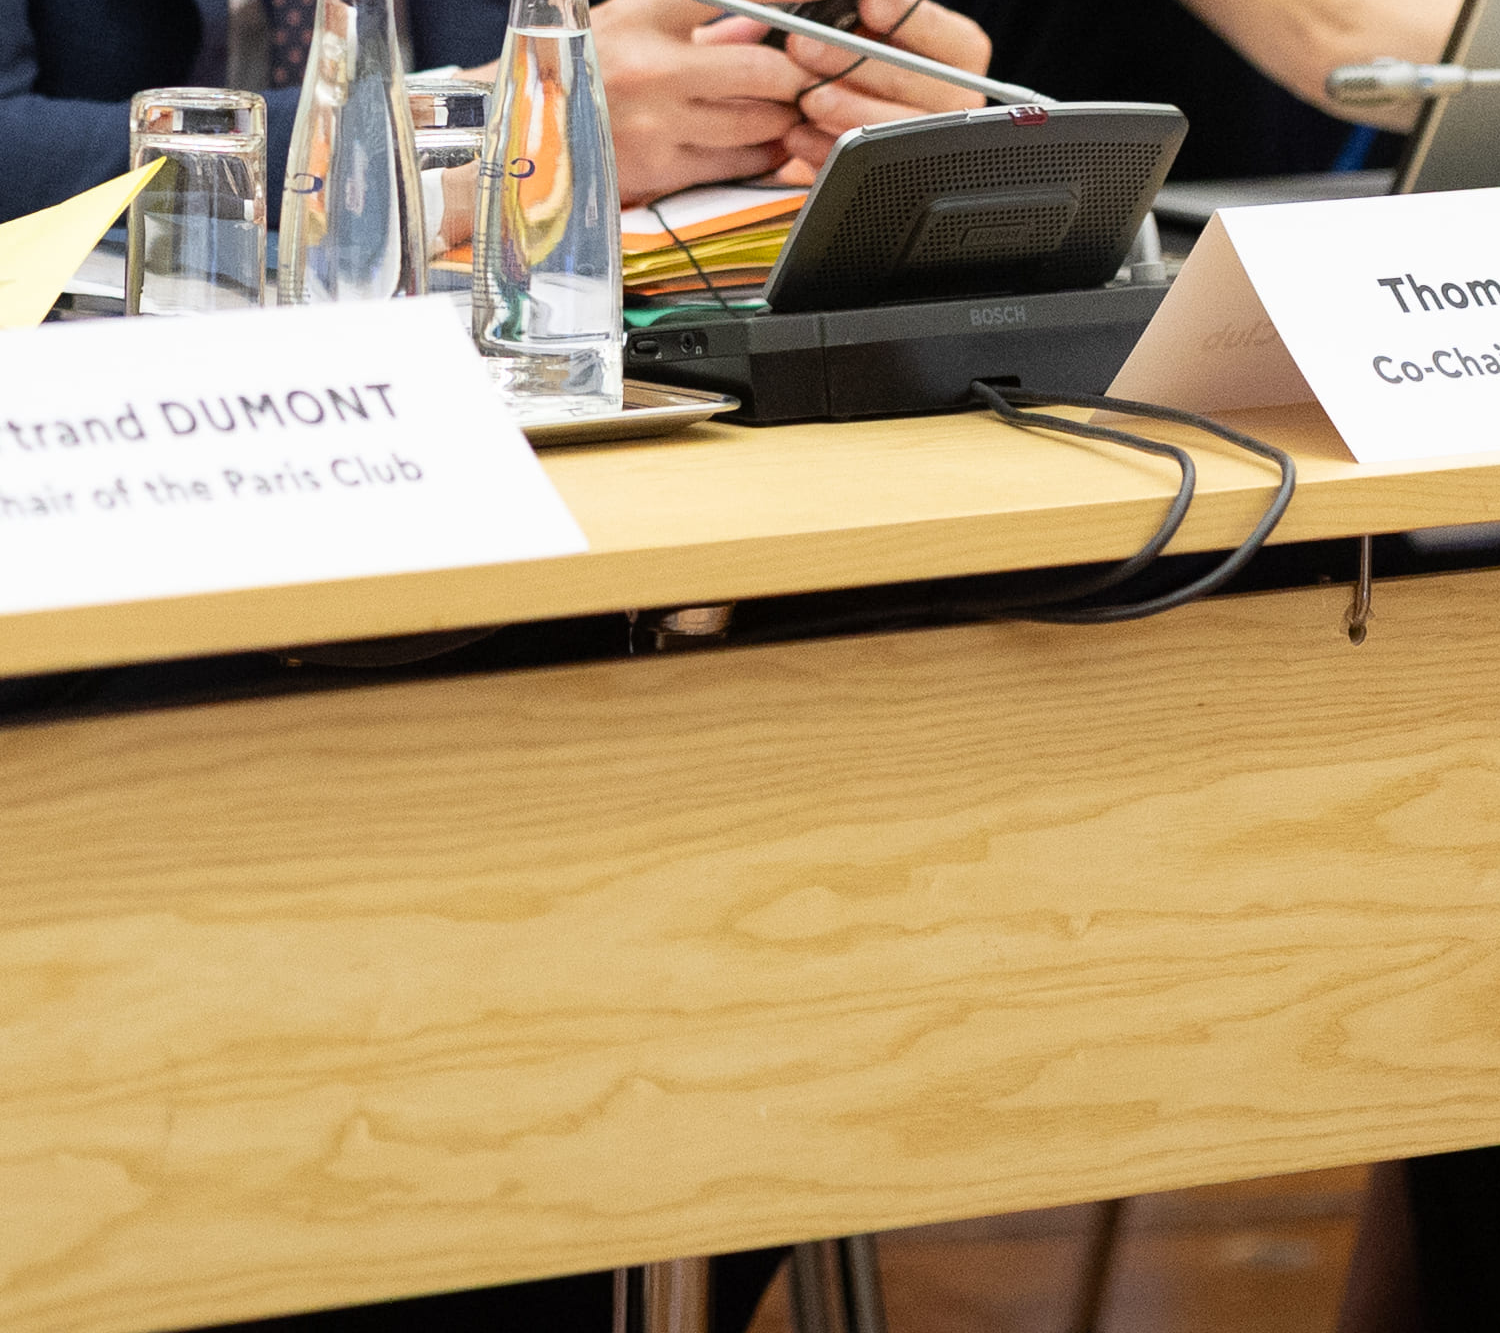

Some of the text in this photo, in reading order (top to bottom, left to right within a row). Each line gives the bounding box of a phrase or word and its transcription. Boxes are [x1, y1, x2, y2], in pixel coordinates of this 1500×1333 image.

[969, 305, 1027, 326] BOSCH
[158, 382, 396, 437] DUMONT
[90, 476, 131, 510] of
[142, 475, 213, 504] the
[222, 463, 322, 496] Paris
[328, 452, 424, 488] Club
